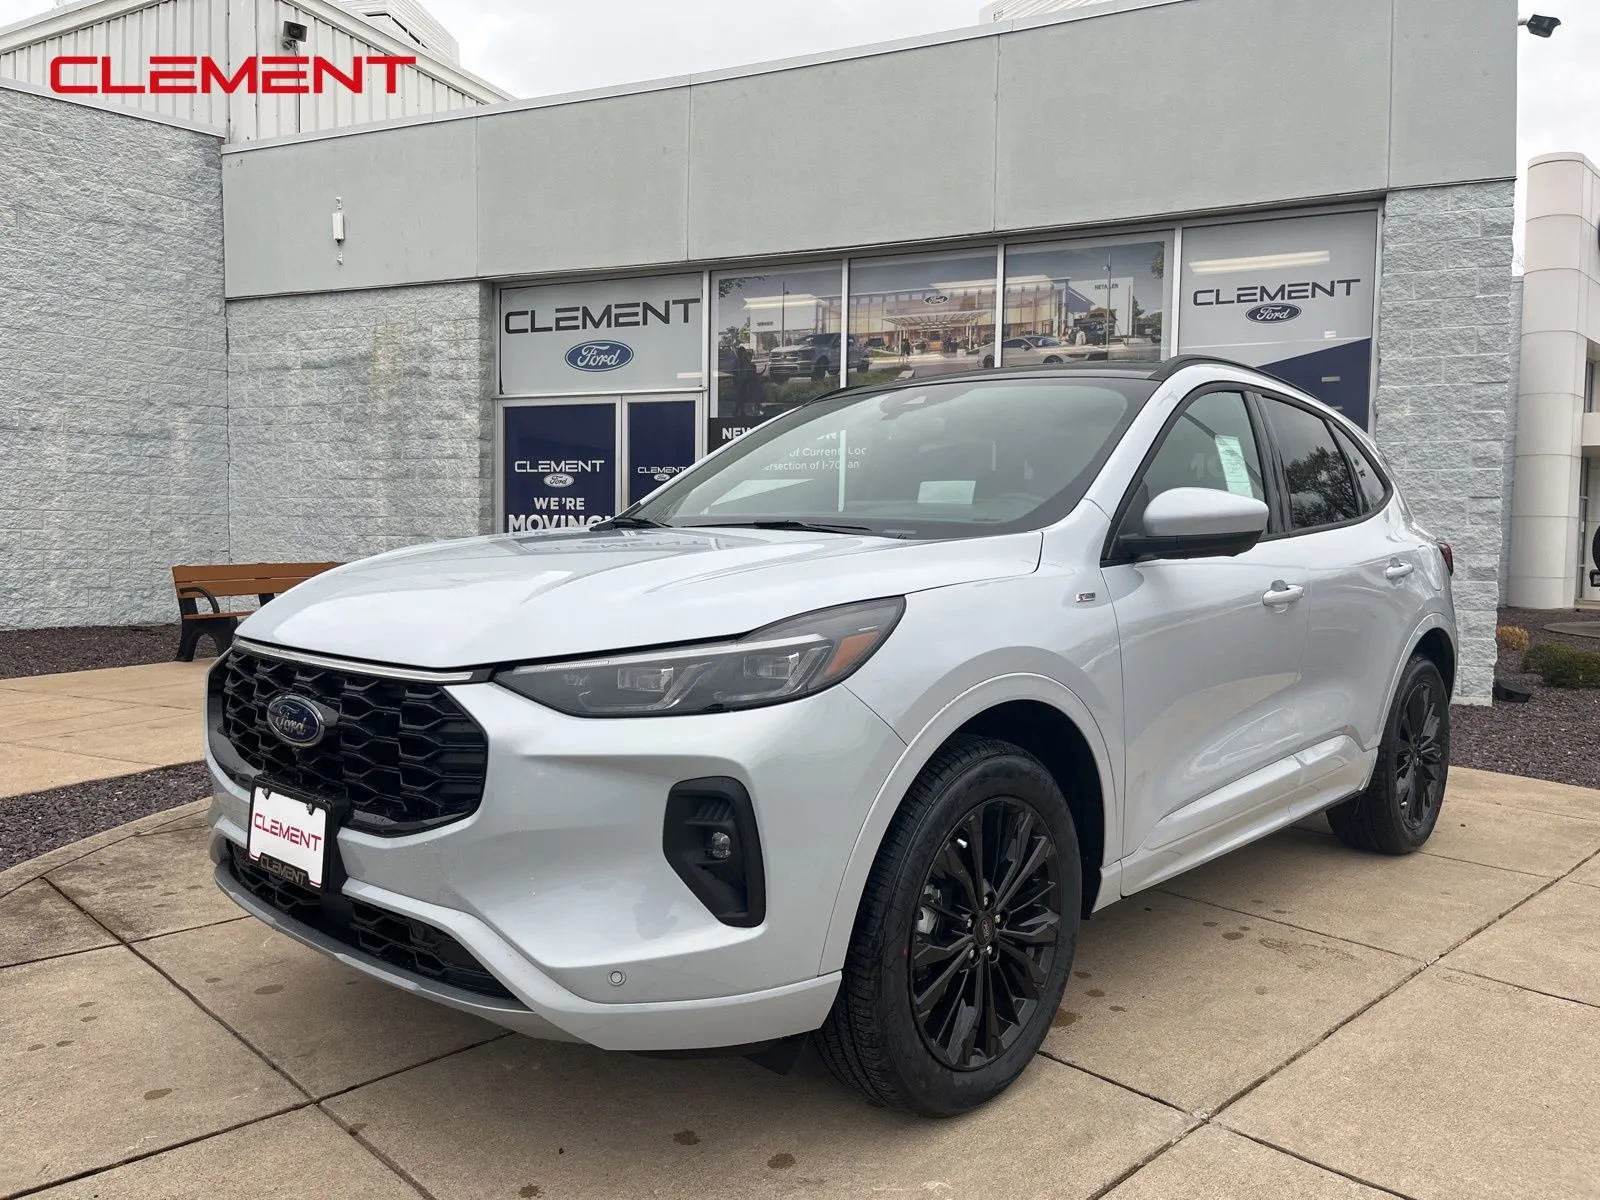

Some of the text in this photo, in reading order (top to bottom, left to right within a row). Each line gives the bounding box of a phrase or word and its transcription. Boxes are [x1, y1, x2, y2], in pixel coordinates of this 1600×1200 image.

[1193, 279, 1361, 306] CLEMENT
[504, 298, 701, 334] CLEMENT
[848, 447, 867, 455] Loc
[514, 460, 605, 473] CLEMENT
[637, 466, 687, 474] CLEMENT
[762, 460, 807, 471] ersection
[809, 460, 820, 470] of
[847, 461, 861, 469] an
[534, 497, 585, 510] WE'RE
[508, 514, 612, 534] MOVIN
[254, 812, 322, 852] CLEMENT
[261, 855, 307, 885] CLEMENT
